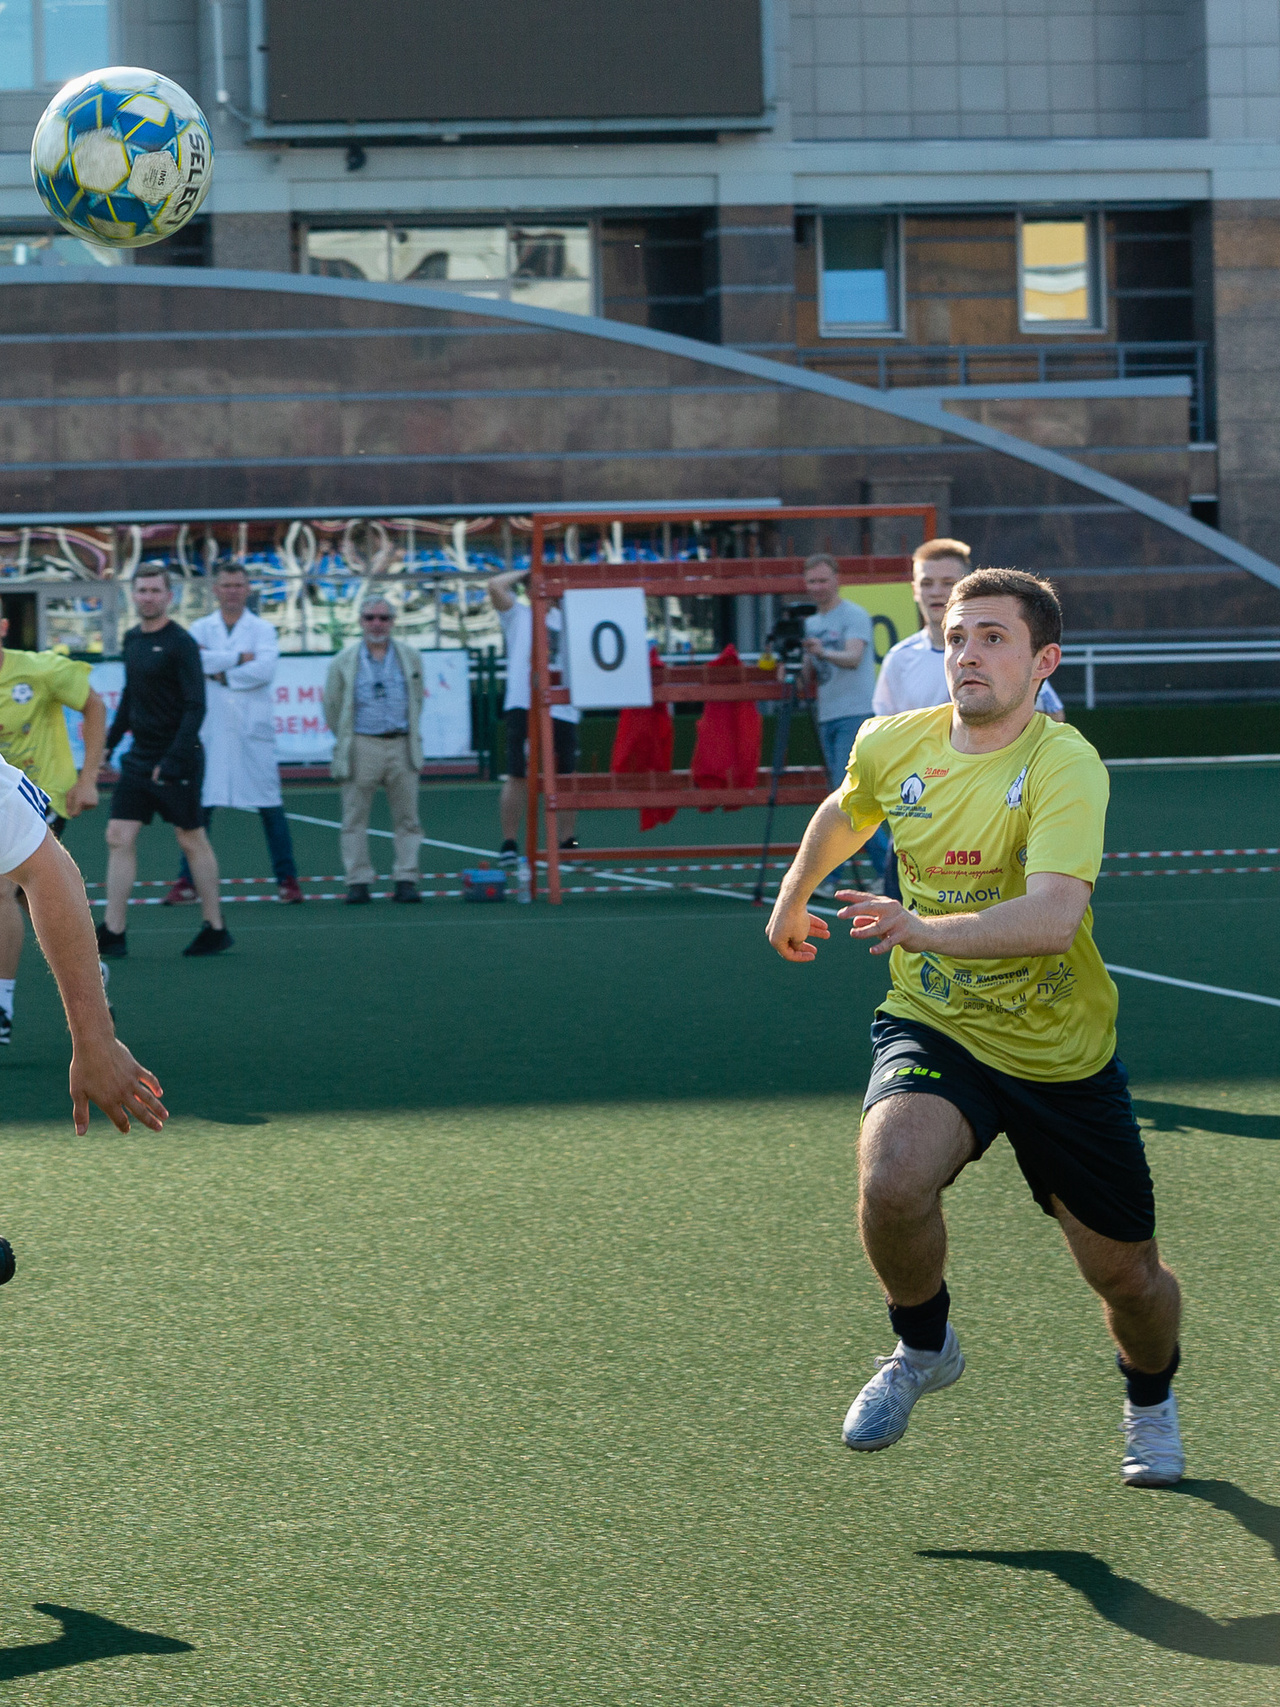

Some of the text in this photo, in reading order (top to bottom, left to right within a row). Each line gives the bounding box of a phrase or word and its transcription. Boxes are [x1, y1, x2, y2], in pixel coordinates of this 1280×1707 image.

[591, 620, 626, 671] 0
[945, 853, 979, 865] ЛСР
[936, 887, 1001, 904] ЭТАЛОН
[918, 903, 950, 915] FORMUL
[953, 966, 1030, 984] ПСБ ЖИЛСТРОЙ
[963, 1001, 985, 1010] GROUP
[986, 1004, 994, 1012] OF
